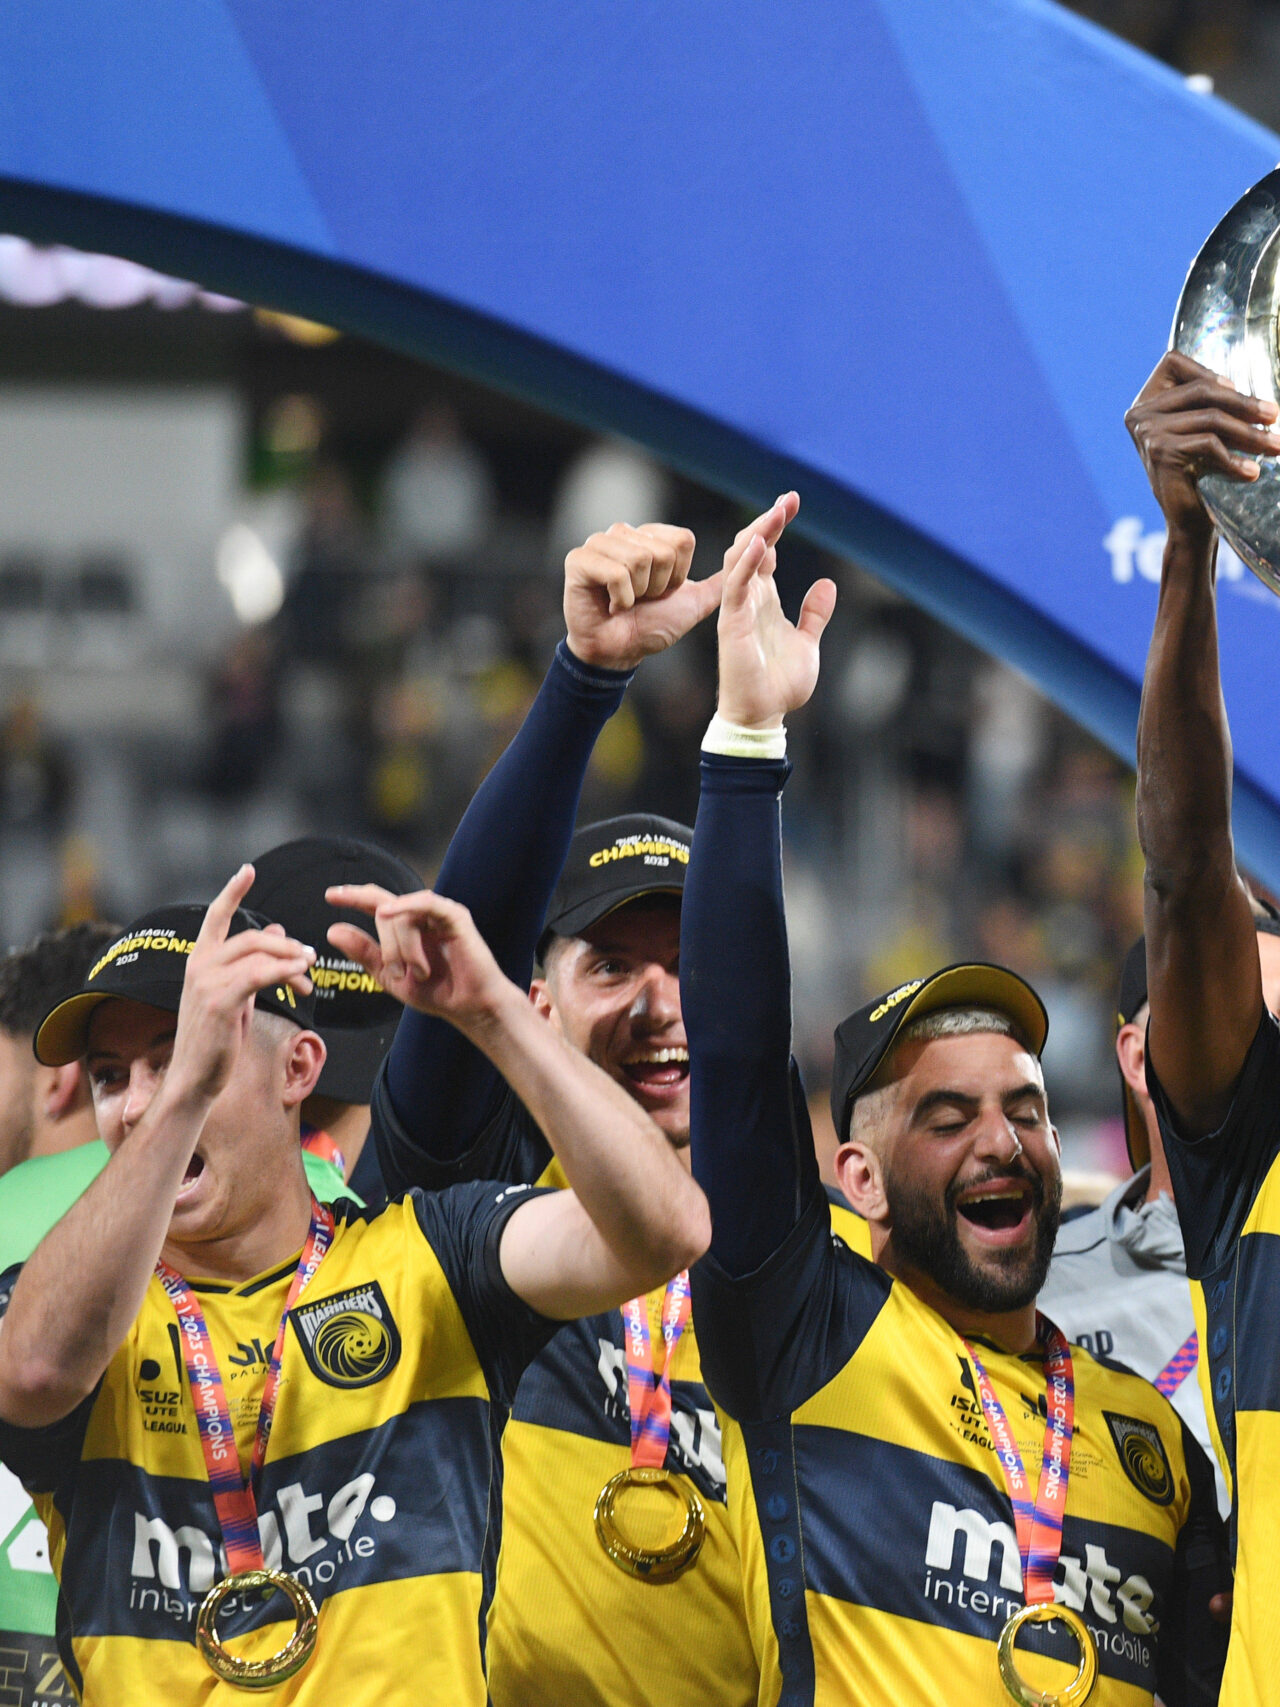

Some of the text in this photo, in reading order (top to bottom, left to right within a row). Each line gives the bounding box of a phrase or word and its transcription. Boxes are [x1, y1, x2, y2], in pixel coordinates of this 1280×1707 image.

[589, 841, 690, 868] CHAMPIO
[115, 951, 140, 967] 2023
[145, 1406, 178, 1417] UTE
[181, 1314, 203, 1351] 2023
[192, 1349, 228, 1461] CHAMPIONS
[981, 1388, 1024, 1490] CHAMPIONS
[1045, 1406, 1067, 1500] CHAMPIONS
